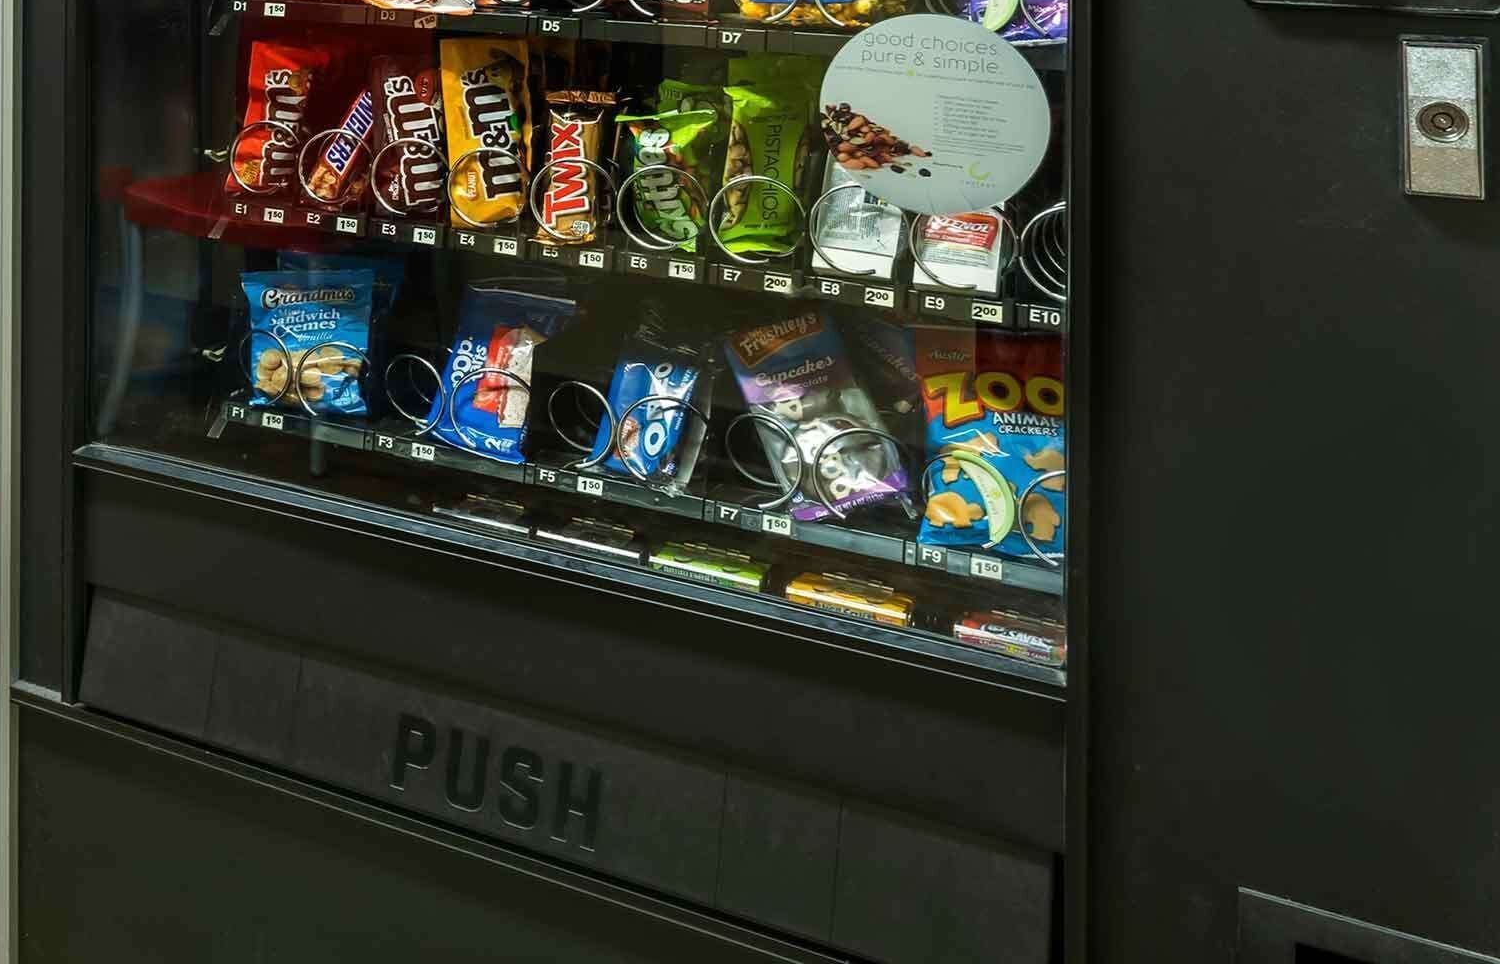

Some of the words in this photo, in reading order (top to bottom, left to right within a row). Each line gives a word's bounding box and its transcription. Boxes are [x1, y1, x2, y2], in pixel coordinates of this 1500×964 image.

[233, 1, 247, 11] D1
[542, 20, 560, 32] D5
[722, 32, 742, 44] D7
[862, 31, 914, 48] good
[920, 35, 997, 56] choices
[861, 49, 907, 65] pure
[914, 51, 925, 67] &
[933, 55, 1000, 75] simple
[543, 122, 587, 225] TWIX
[762, 124, 782, 221] PISTACHIOS
[235, 204, 247, 214] E1
[307, 213, 321, 224] E2
[382, 224, 396, 235] E3
[459, 234, 475, 246] E4
[543, 246, 559, 257] E5
[630, 256, 648, 269] E6
[723, 269, 741, 282] E7
[821, 282, 841, 296] E8
[925, 296, 945, 310] E9
[270, 308, 341, 326] Sandwich
[1029, 309, 1061, 325] E10
[755, 354, 836, 387] Cupcakes
[923, 371, 1065, 426] ZOO
[231, 407, 245, 418] F1
[992, 411, 1061, 427] ANIMAL
[998, 424, 1059, 437] CRACKERS
[378, 436, 393, 448] F3
[539, 469, 556, 483] F5
[719, 507, 739, 521] F7
[921, 549, 942, 564] F9
[389, 712, 603, 853] PUSH
